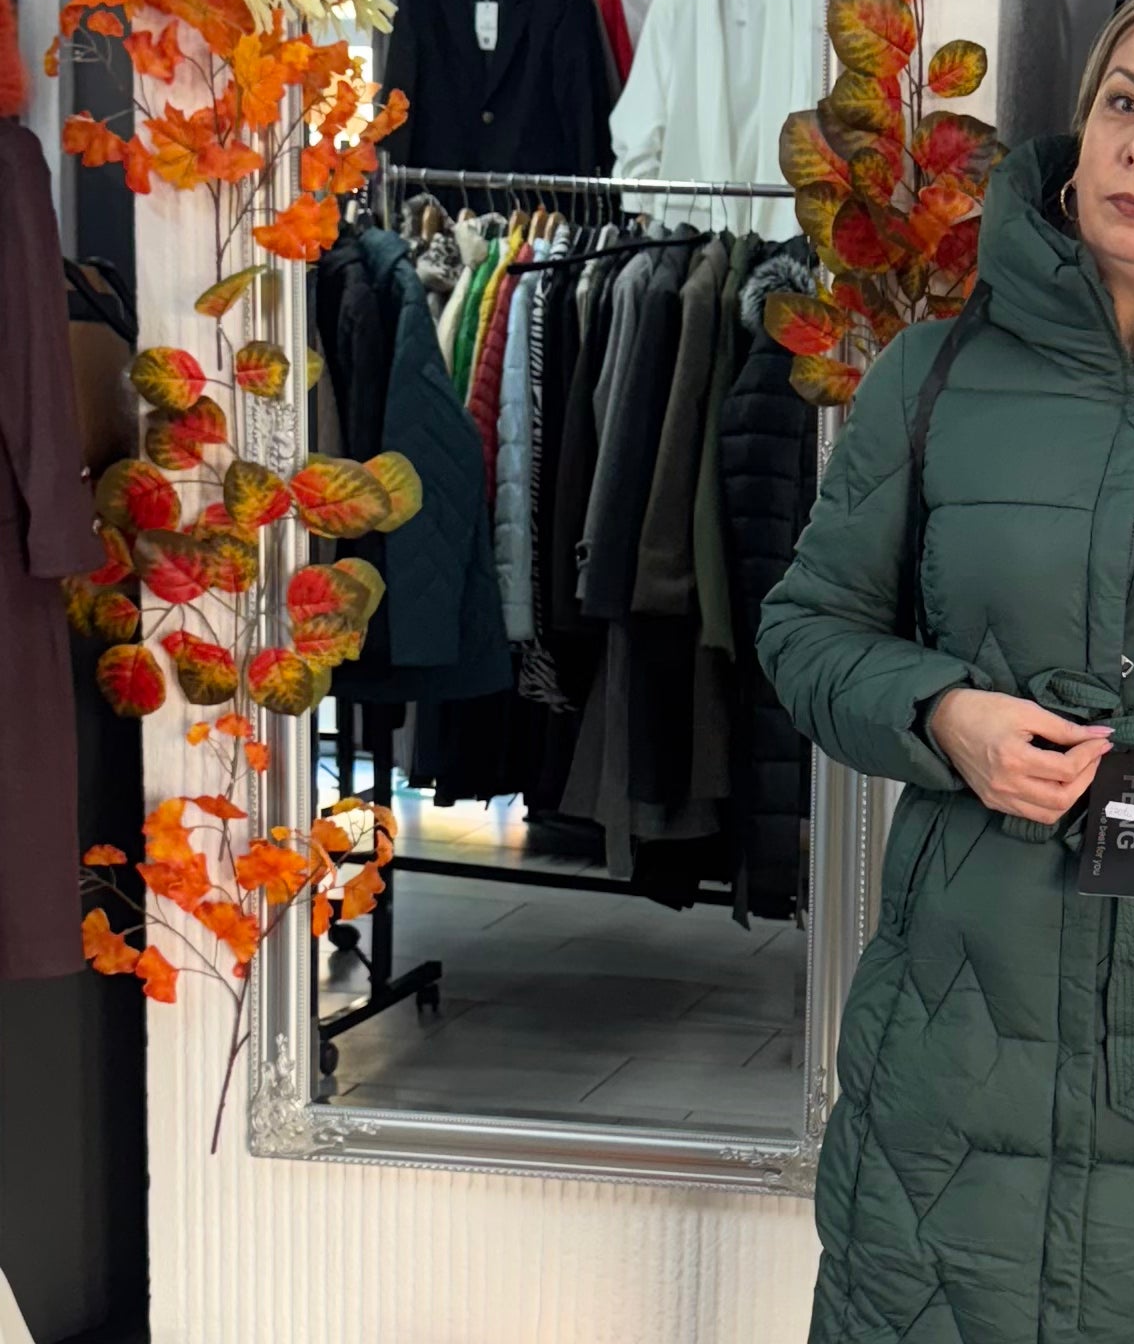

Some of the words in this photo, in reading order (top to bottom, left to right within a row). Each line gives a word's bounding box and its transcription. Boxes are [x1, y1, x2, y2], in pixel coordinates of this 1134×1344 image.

[1098, 825, 1108, 845] best
[1095, 846, 1106, 858] for
[1092, 859, 1102, 876] you
